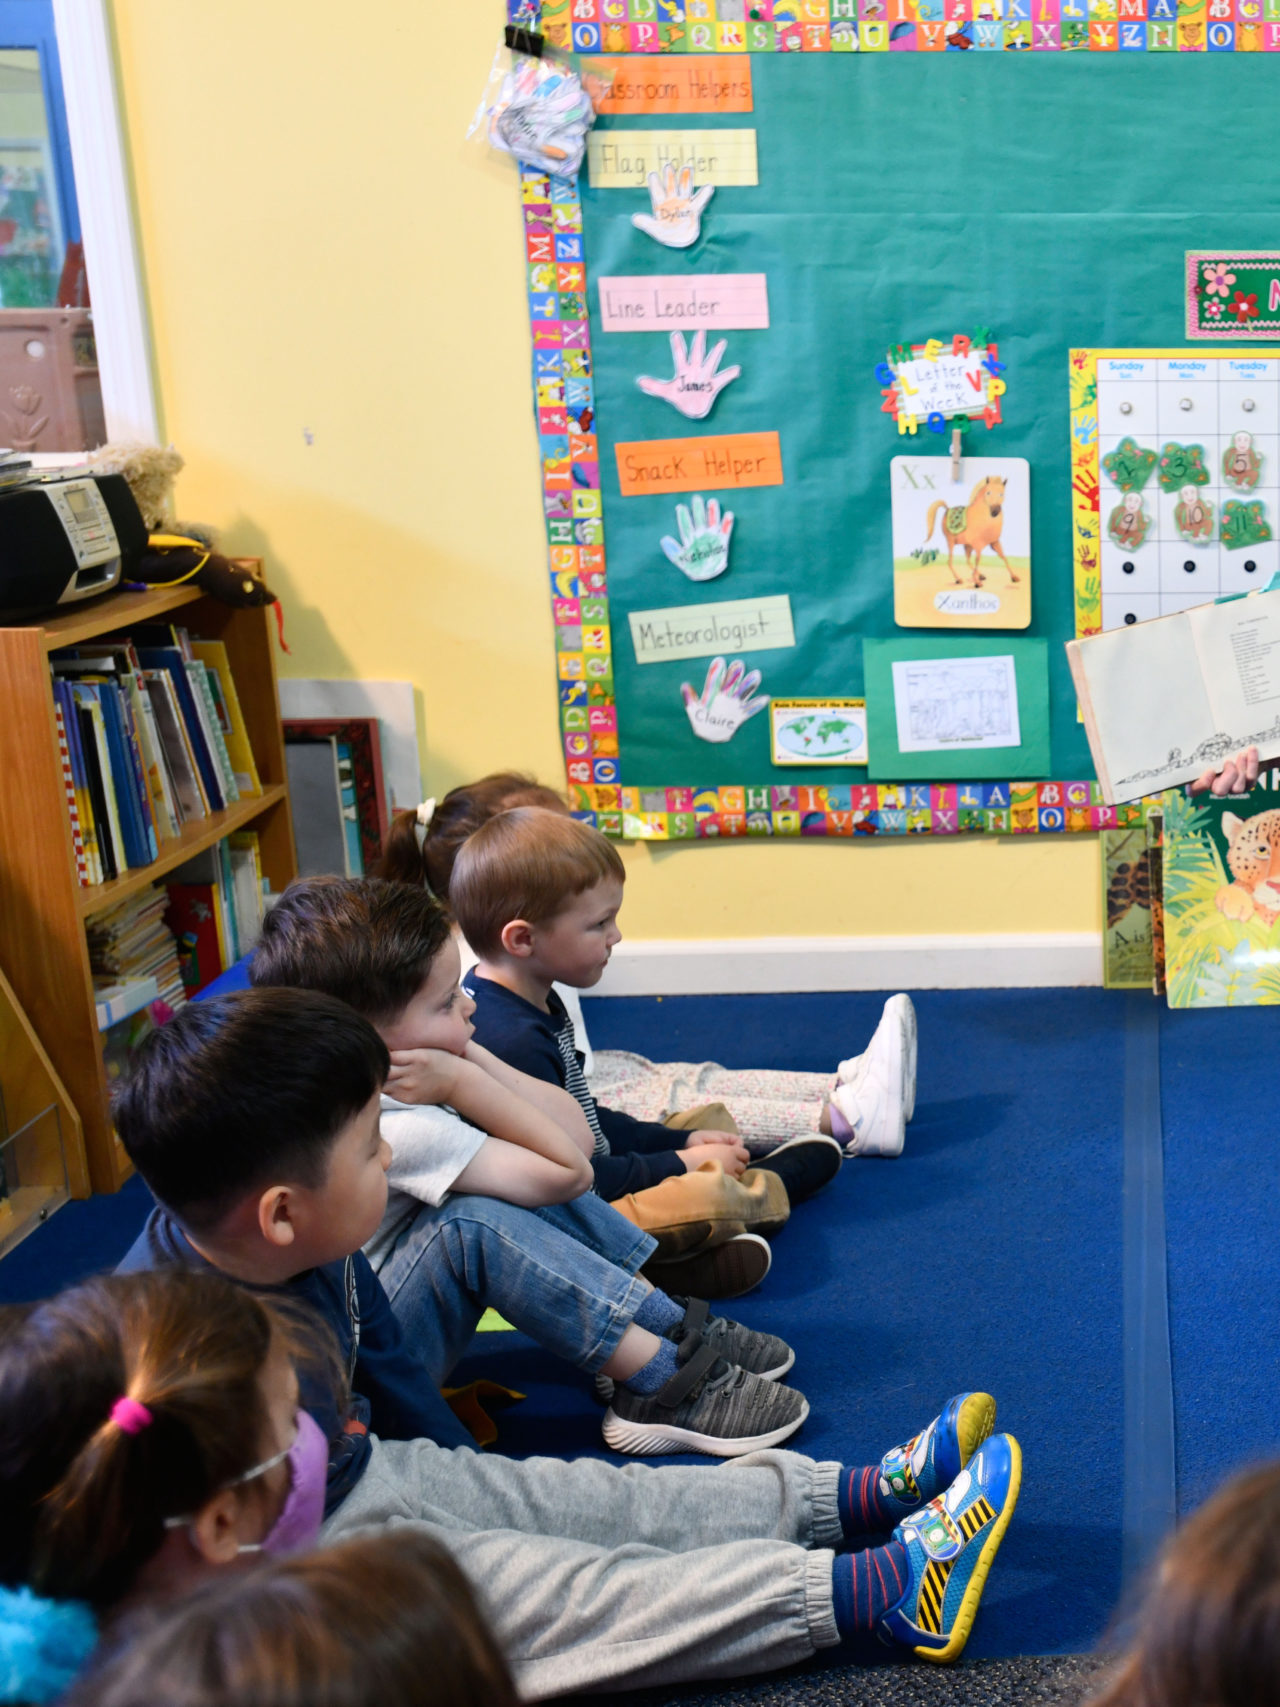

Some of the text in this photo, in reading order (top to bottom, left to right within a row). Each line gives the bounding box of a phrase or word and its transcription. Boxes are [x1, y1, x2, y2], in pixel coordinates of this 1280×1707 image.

[688, 68, 750, 106] Helpers
[602, 143, 718, 185] Flag Holder
[606, 289, 720, 319] Line Leader
[915, 365, 965, 382] Letter
[1109, 361, 1144, 372] Sunday
[1168, 361, 1206, 372] Monday
[1229, 361, 1268, 372] Tuesday
[677, 375, 713, 393] James
[920, 392, 969, 411] Week
[625, 449, 766, 482] Snack Helper
[1171, 456, 1188, 479] 3
[1234, 453, 1248, 474] 5
[1188, 506, 1204, 526] 10
[938, 594, 997, 612] Xanthos
[638, 609, 770, 651] Meteorologist
[694, 708, 736, 731] Claire
